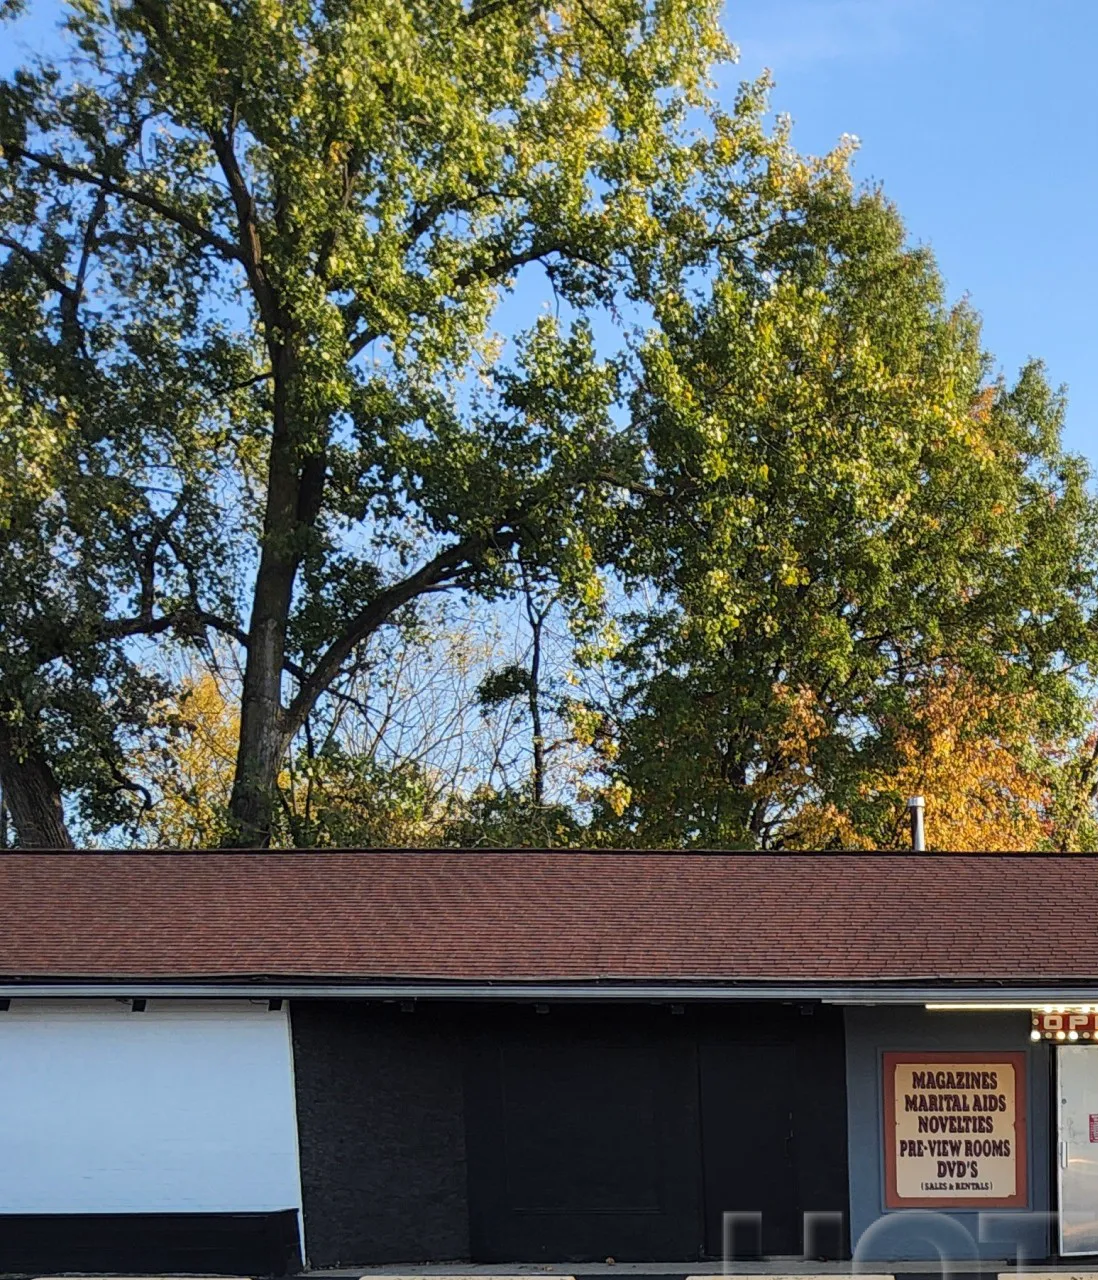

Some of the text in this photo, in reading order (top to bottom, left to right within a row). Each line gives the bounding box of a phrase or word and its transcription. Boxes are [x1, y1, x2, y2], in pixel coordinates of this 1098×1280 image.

[912, 1071, 998, 1090] MAGAZINES
[904, 1094, 1007, 1112] MARITAL AIDS
[918, 1115, 994, 1134] NOVELTIES
[900, 1139, 1011, 1157] PRE-VIEW ROOMS
[937, 1160, 979, 1178] DVD'S
